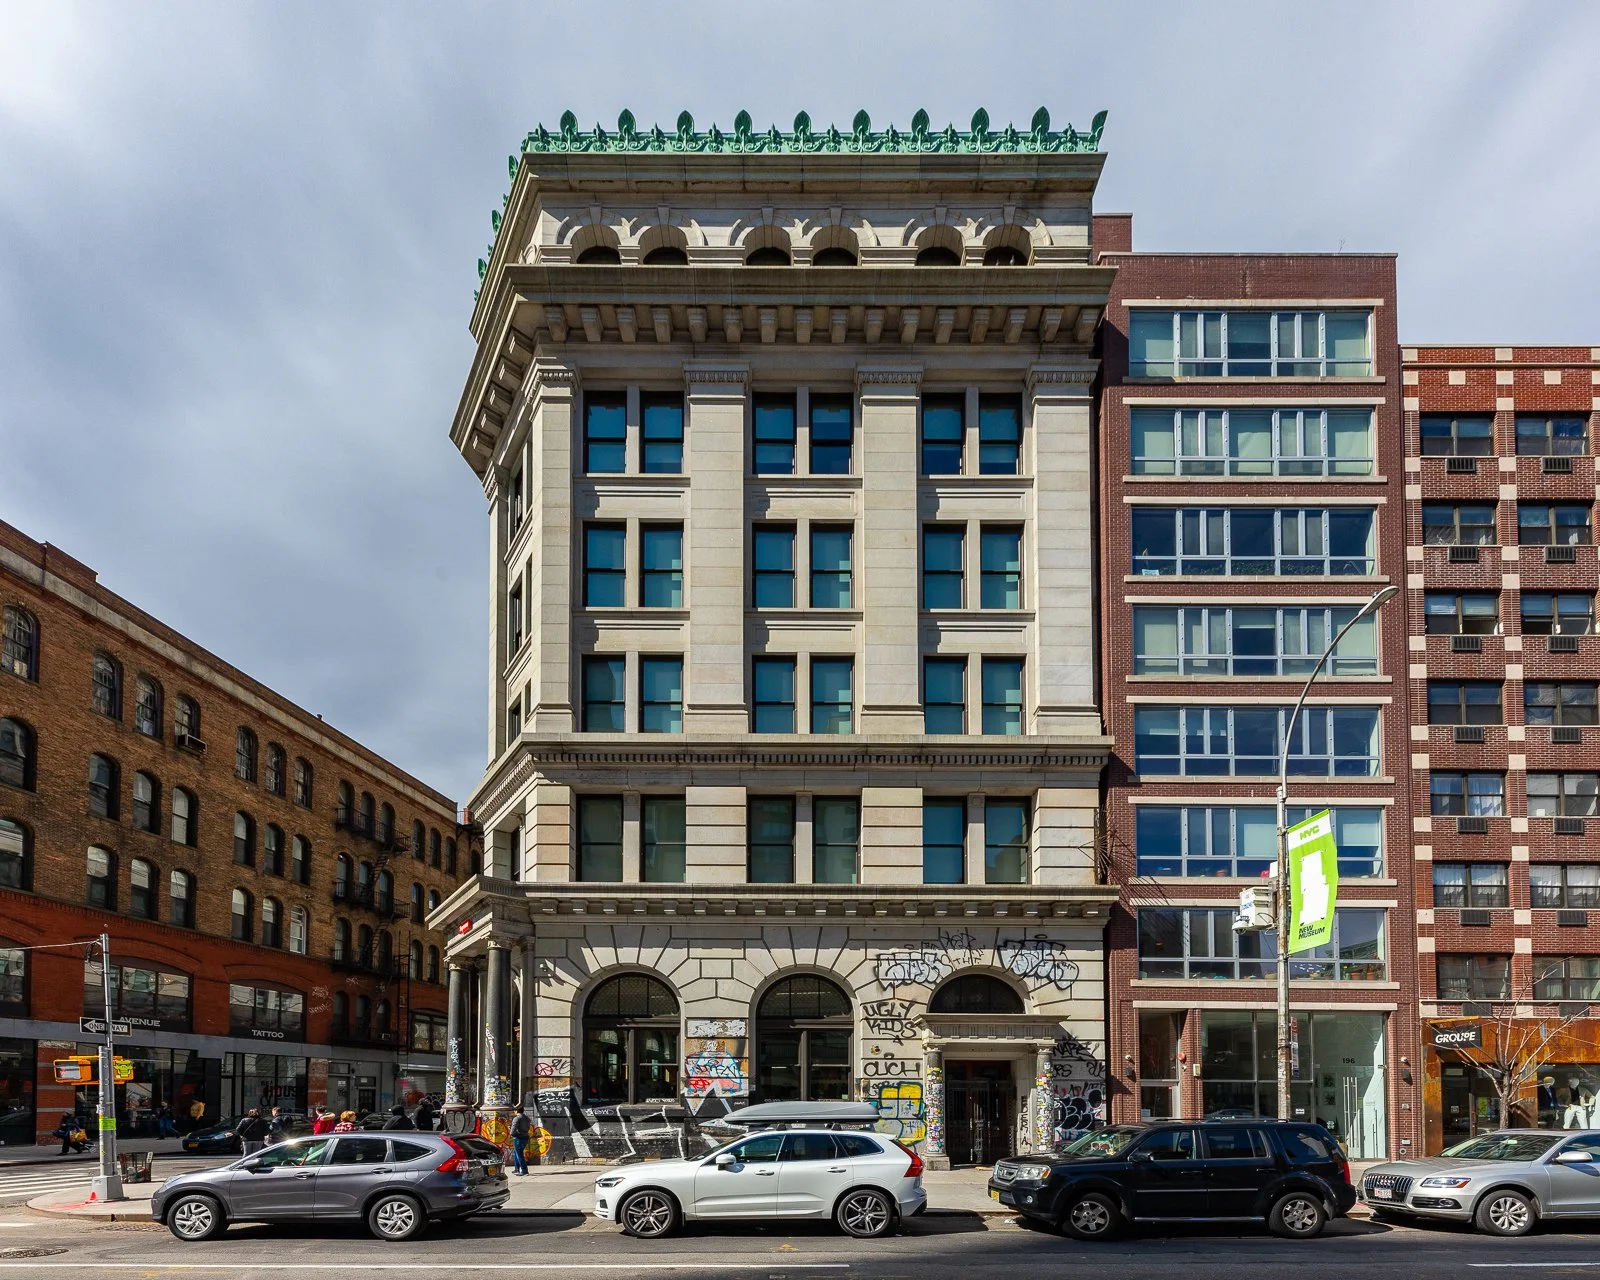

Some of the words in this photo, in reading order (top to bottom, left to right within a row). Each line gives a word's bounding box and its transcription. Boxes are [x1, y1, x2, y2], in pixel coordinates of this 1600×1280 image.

[1300, 825, 1320, 840] NYC
[1298, 926, 1325, 939] MUSEUM
[1299, 924, 1314, 935] NEW
[863, 1001, 915, 1020] UGLY
[88, 1022, 104, 1031] ONE
[120, 1016, 160, 1027] AVENUE
[865, 1017, 918, 1038] KIDS
[252, 1029, 284, 1039] TATTOO
[1435, 1031, 1476, 1043] GROUPE
